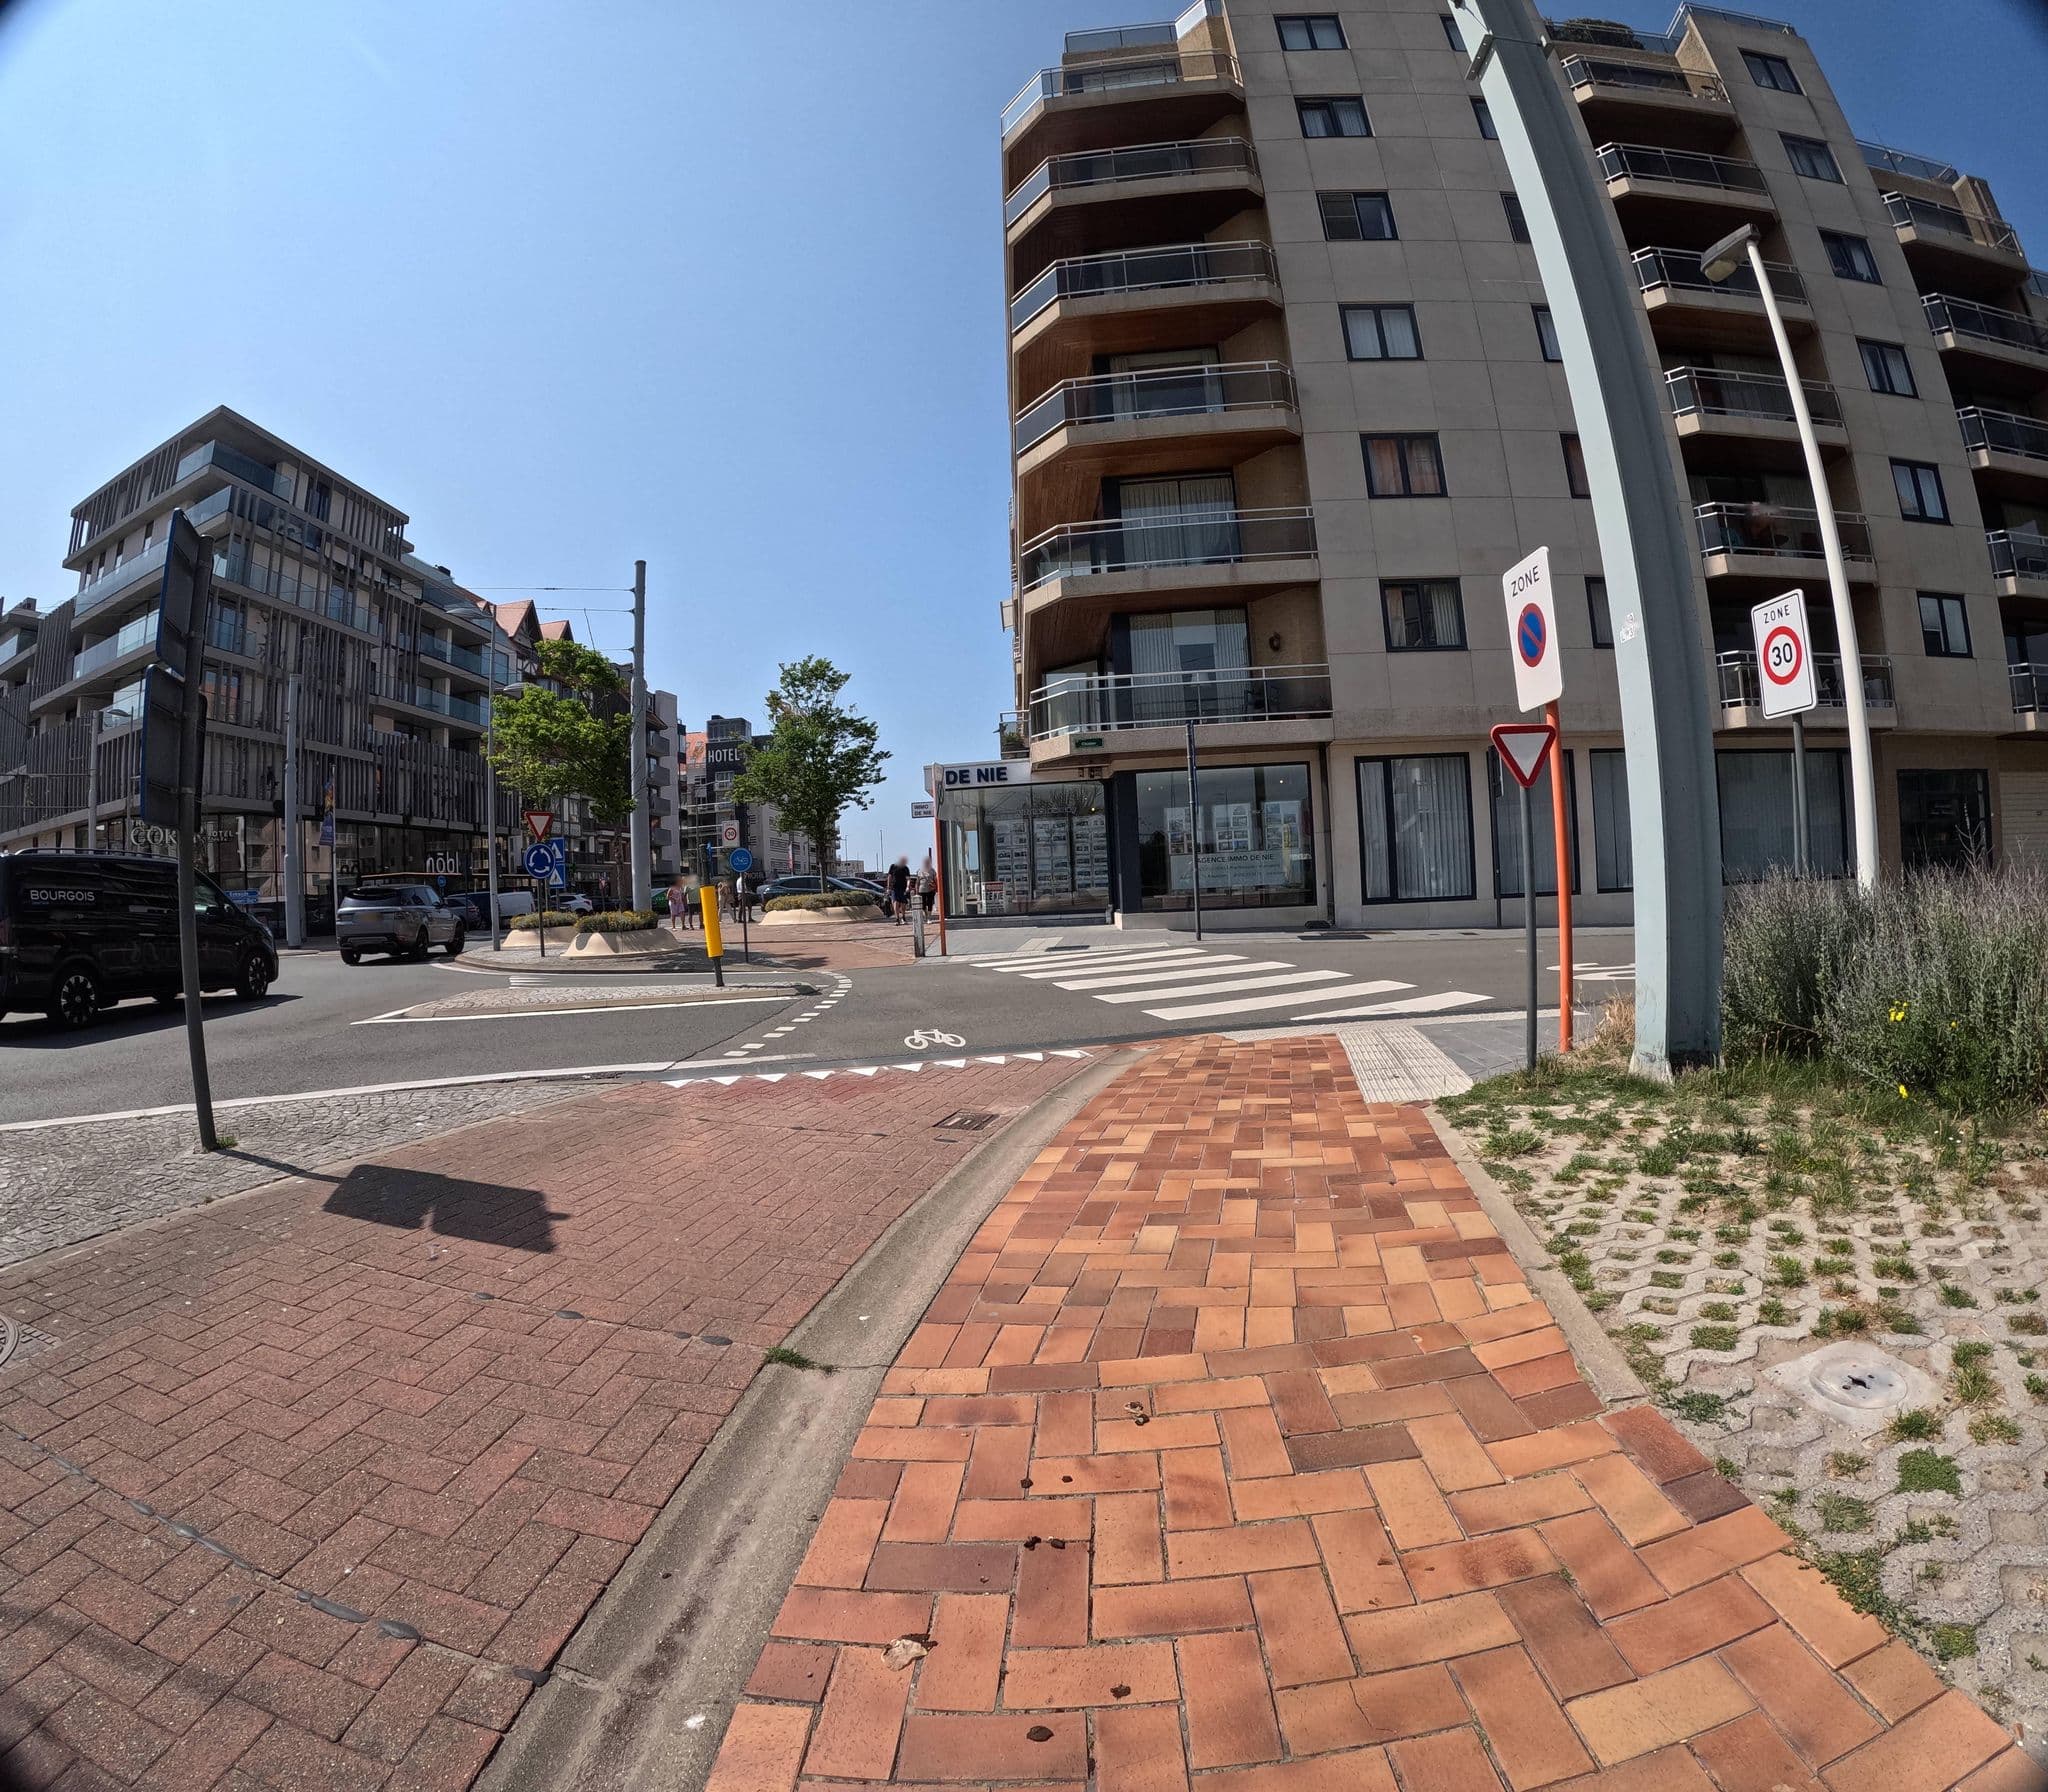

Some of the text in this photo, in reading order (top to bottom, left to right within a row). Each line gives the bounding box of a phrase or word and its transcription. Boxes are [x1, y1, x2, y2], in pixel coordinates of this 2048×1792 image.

[1510, 565, 1540, 597] ZONE
[1763, 604, 1790, 624] ZONE
[1771, 642, 1793, 667] 30
[708, 748, 740, 762] HOTEL
[945, 766, 1008, 785] DE NIE
[30, 889, 95, 901] BOURGOIS
